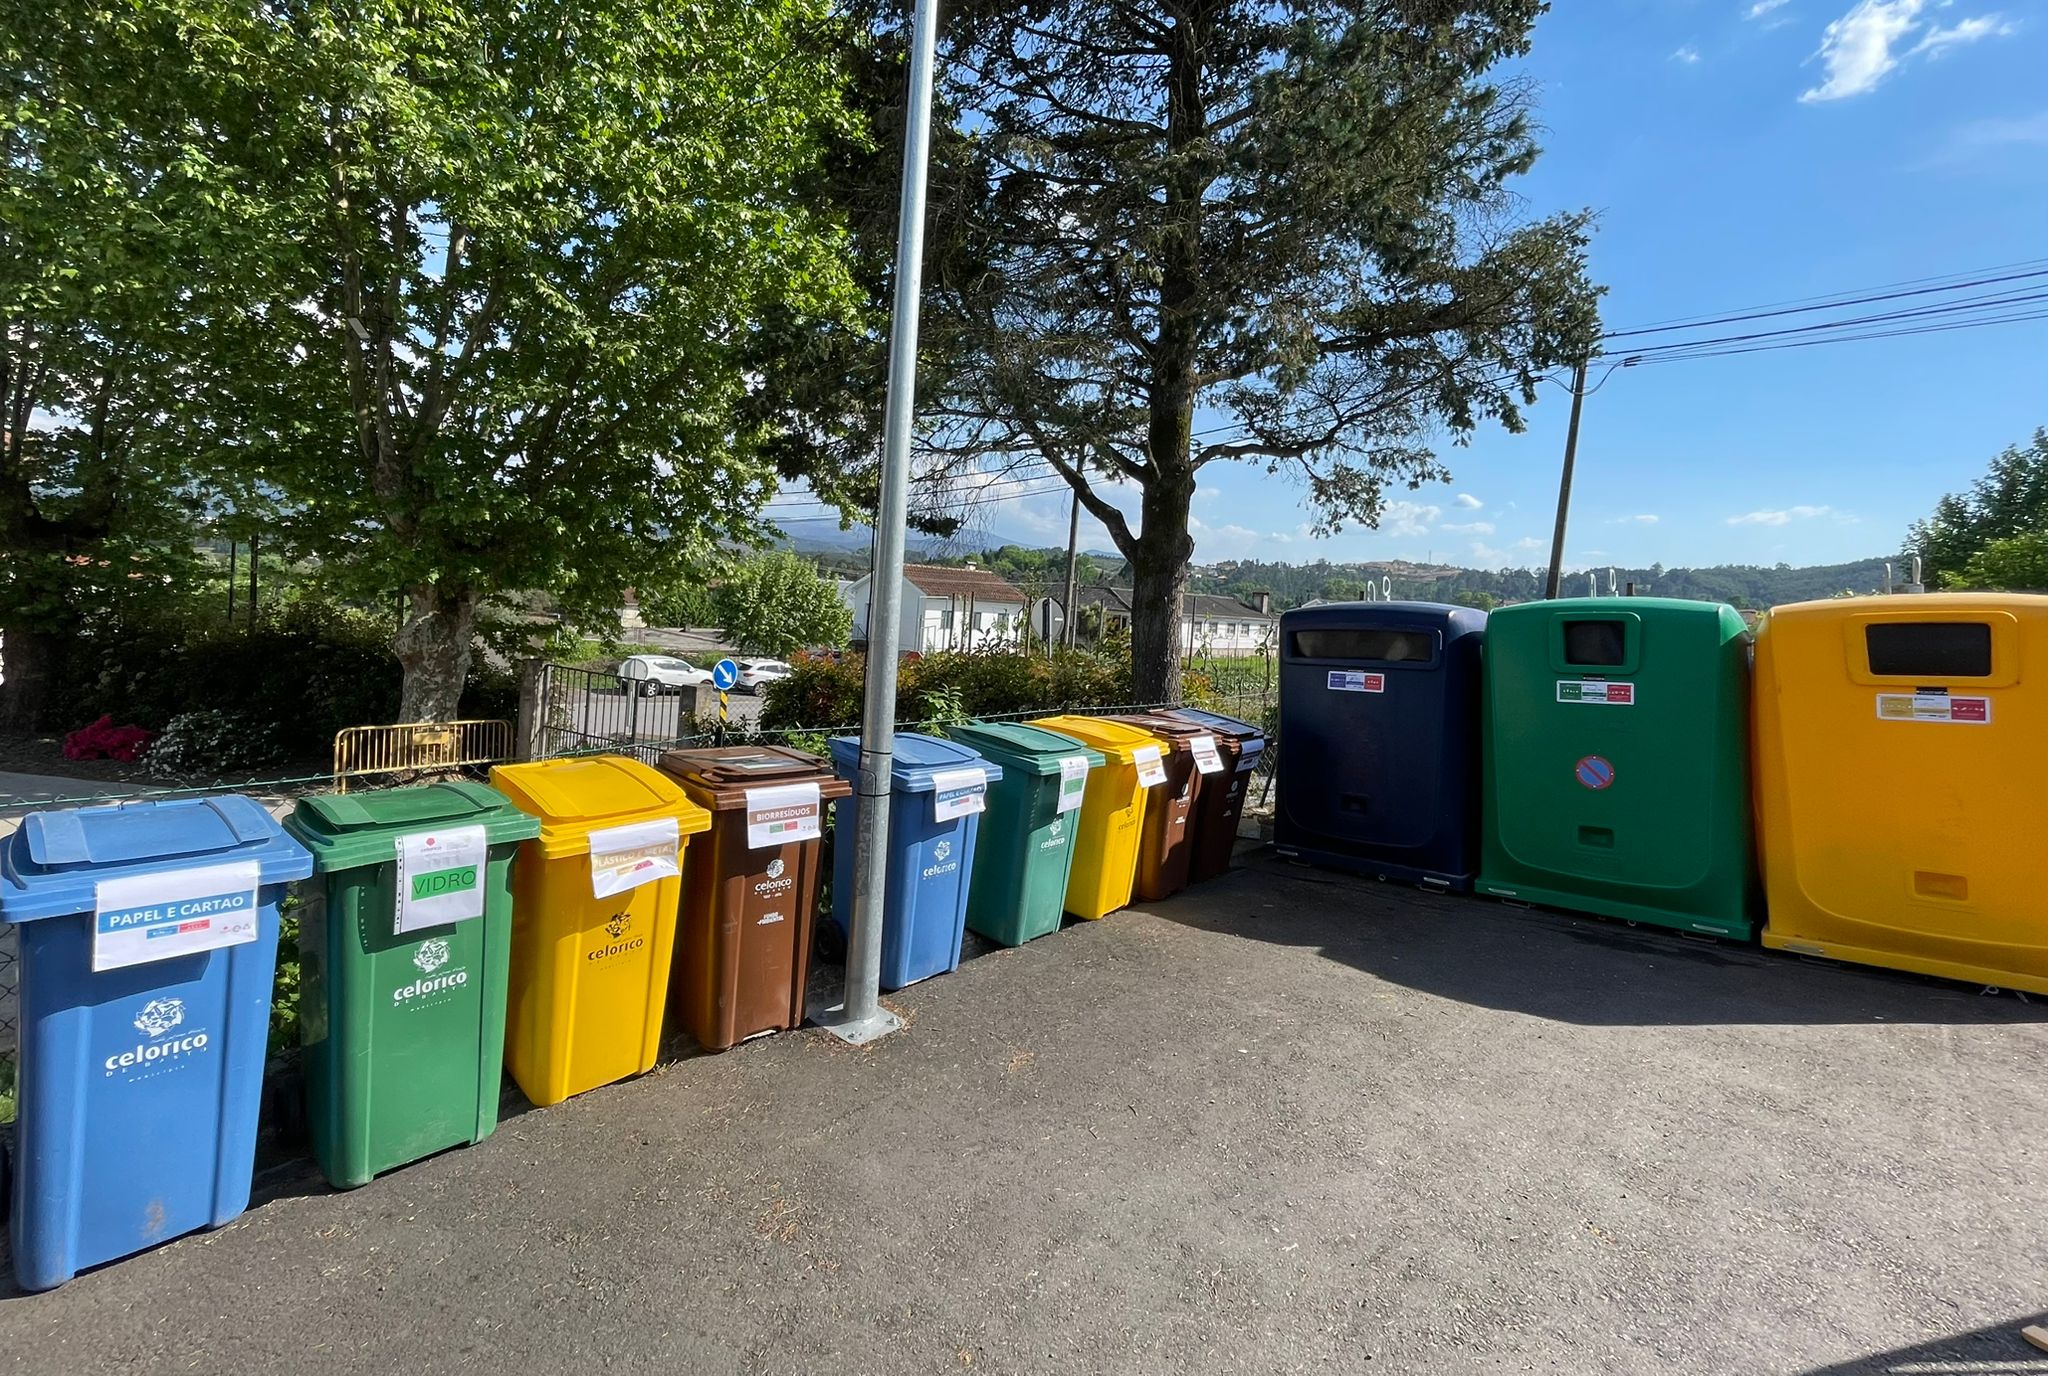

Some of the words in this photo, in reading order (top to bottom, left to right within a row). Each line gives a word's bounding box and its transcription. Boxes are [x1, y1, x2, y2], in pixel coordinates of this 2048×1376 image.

[756, 806, 811, 822] BIORRESÍDUOS
[923, 862, 957, 877] celorico
[412, 870, 476, 895] VIDRO
[754, 878, 792, 892] celorico
[109, 909, 162, 928] PAPEL
[167, 906, 177, 918] E
[587, 938, 644, 961] celorico
[393, 972, 467, 1001] celorico
[105, 1033, 208, 1070] celorico
